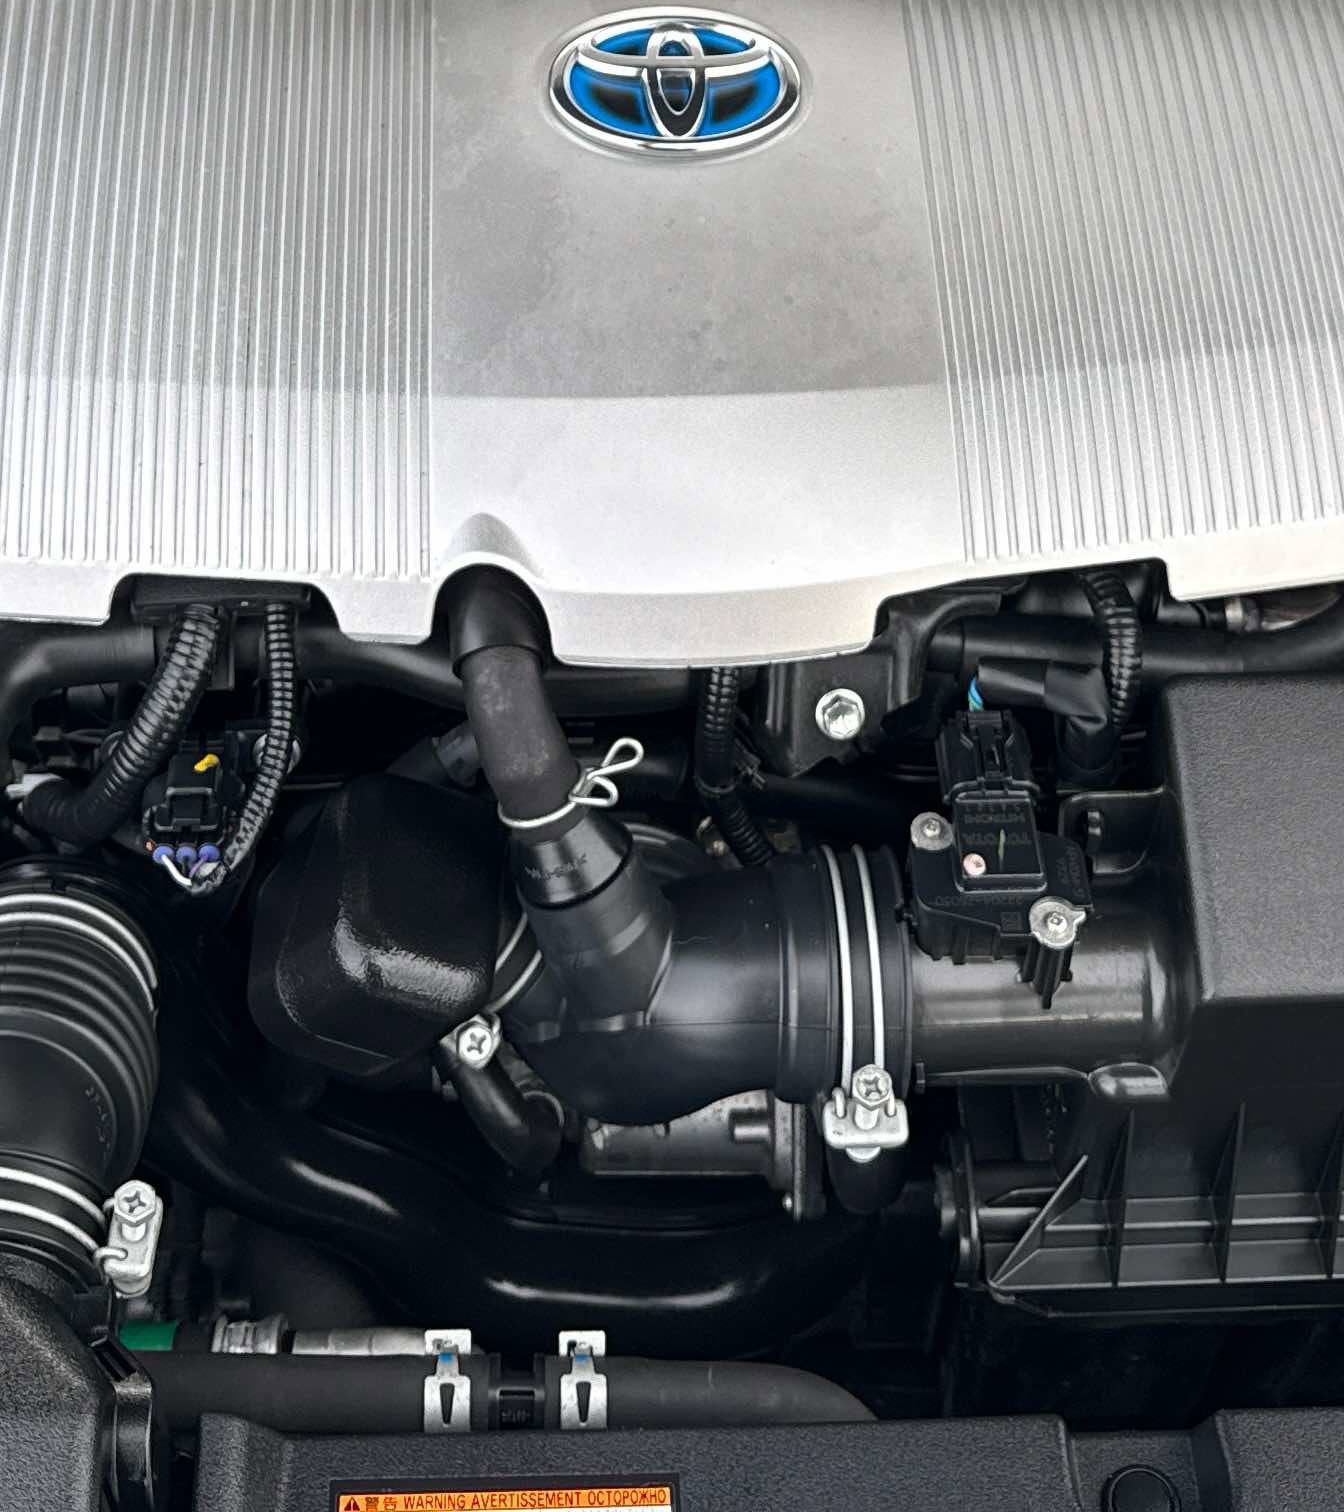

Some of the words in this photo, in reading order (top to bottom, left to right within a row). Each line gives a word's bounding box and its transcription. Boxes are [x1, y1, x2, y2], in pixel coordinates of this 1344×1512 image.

[403, 1494, 466, 1510] WARNING
[471, 1490, 582, 1508] AVERTISSEMENT
[588, 1489, 667, 1506] ОСТОРОЖНО
